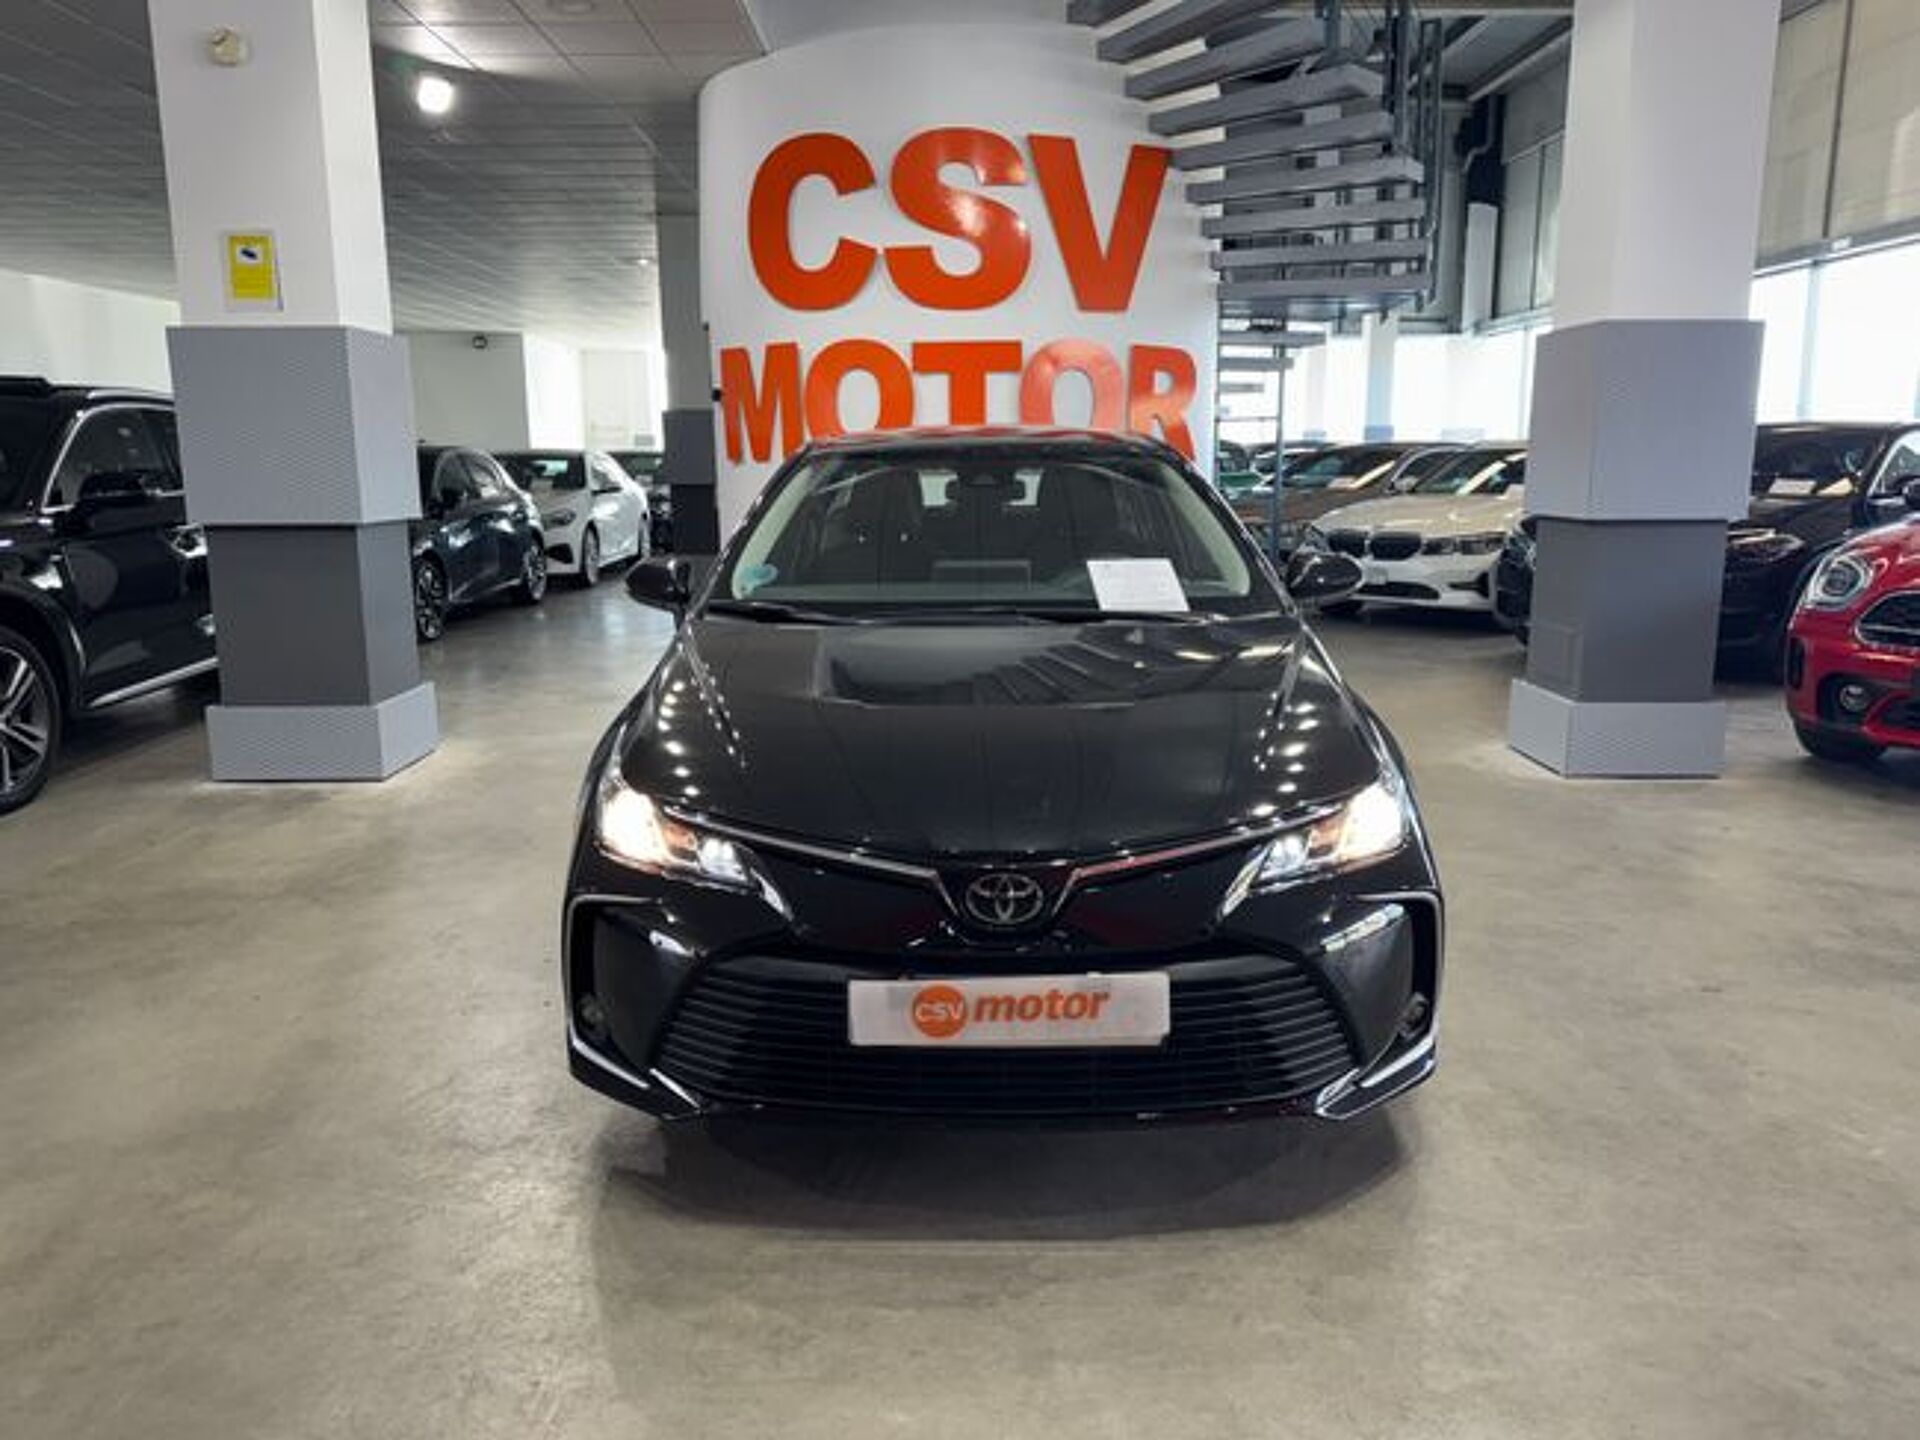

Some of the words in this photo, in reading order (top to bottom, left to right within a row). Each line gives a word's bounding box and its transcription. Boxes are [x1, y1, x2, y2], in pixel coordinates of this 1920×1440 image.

[748, 127, 1174, 312] CSV
[720, 339, 1197, 464] MOTOR
[974, 988, 1110, 1022] motor
